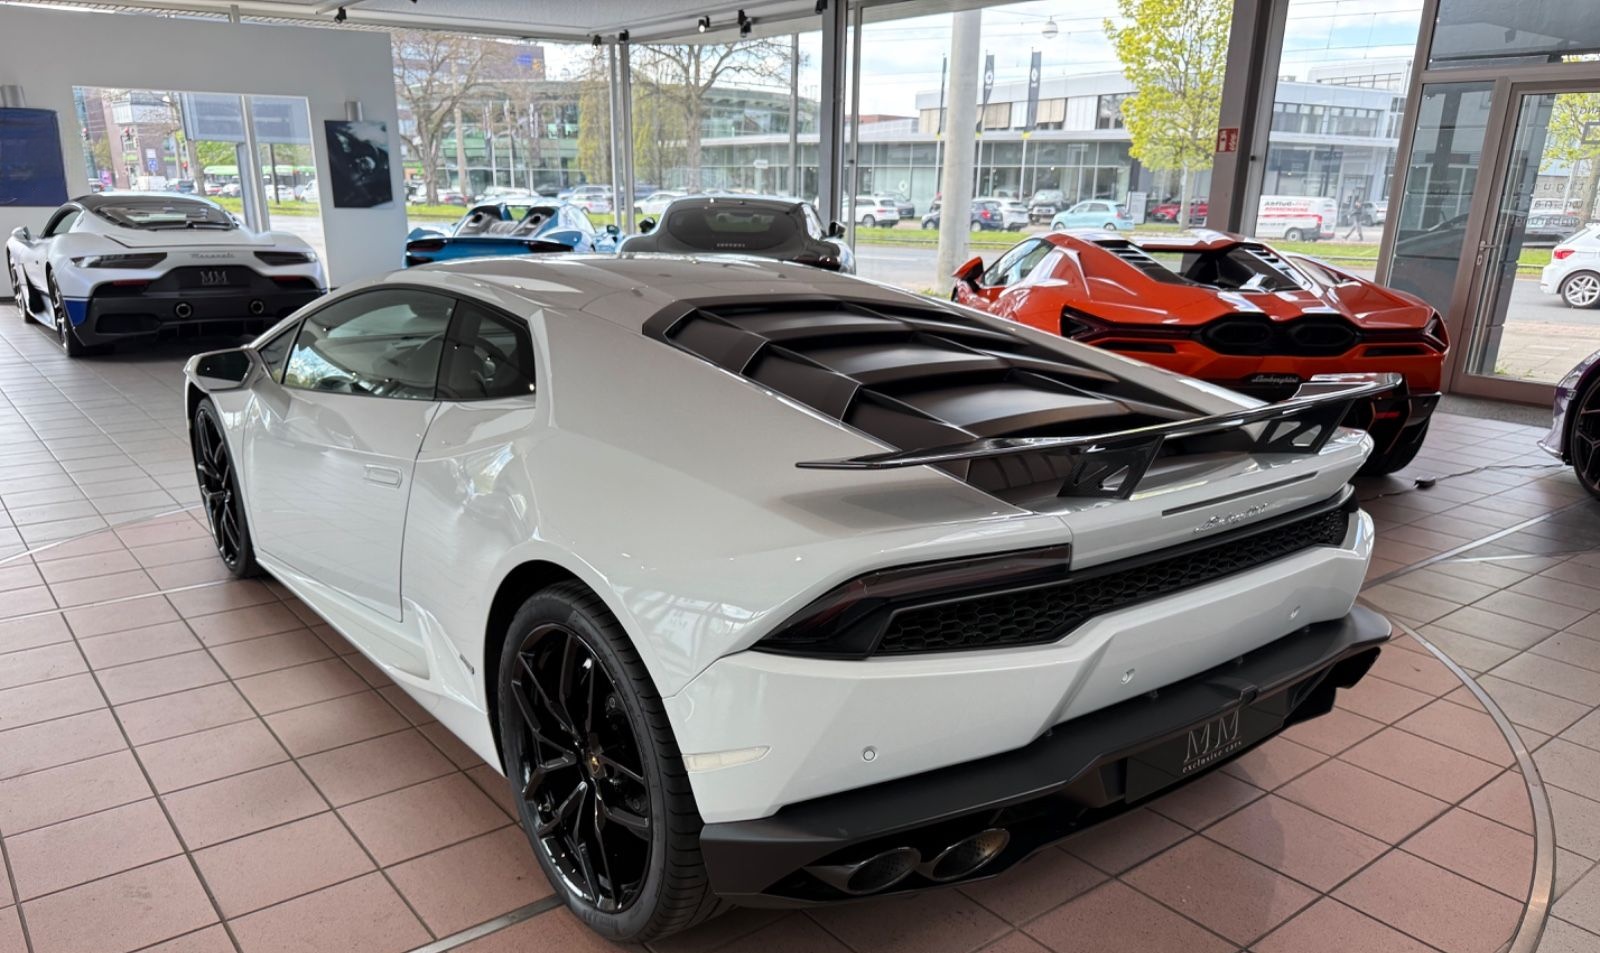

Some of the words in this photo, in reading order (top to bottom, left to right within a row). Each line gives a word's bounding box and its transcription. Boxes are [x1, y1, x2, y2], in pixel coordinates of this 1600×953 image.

[1182, 750, 1222, 773] exclusive
[1225, 740, 1241, 753] cars
[1184, 709, 1239, 763] MM
